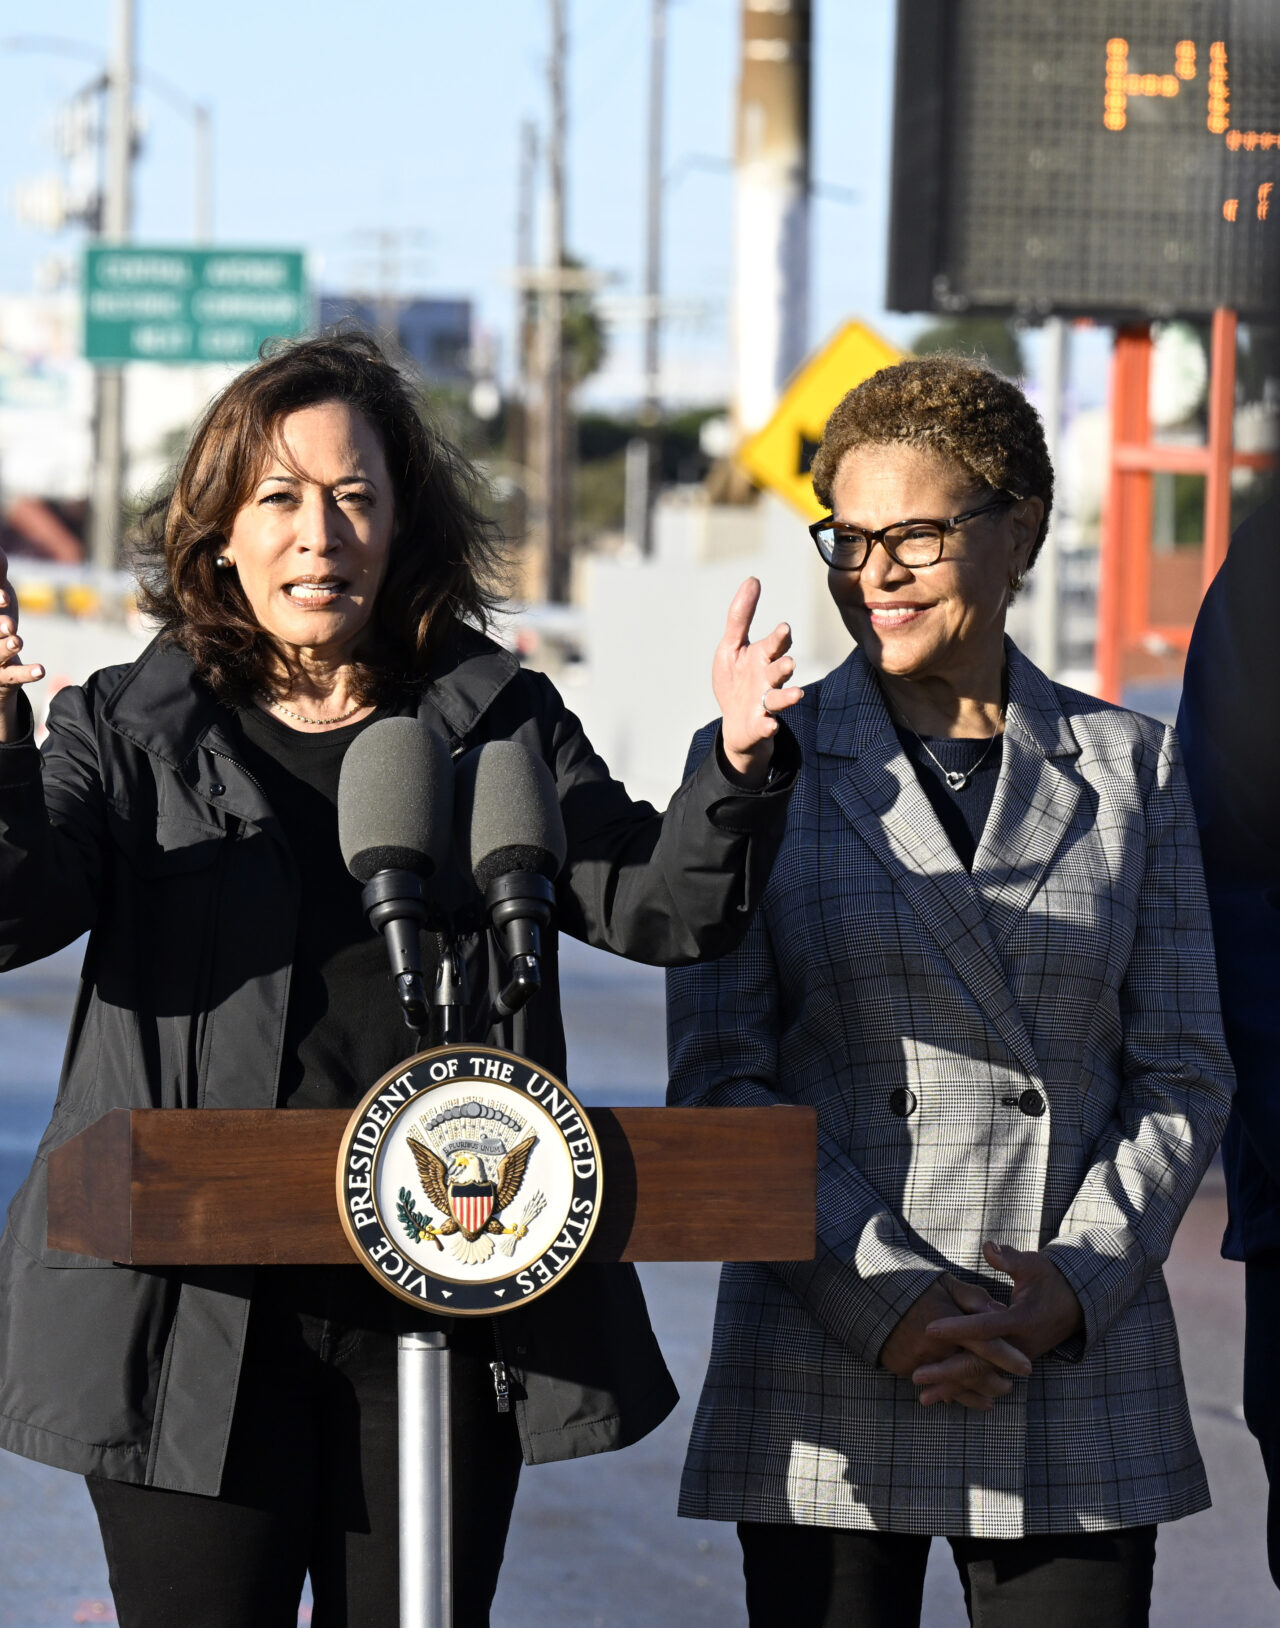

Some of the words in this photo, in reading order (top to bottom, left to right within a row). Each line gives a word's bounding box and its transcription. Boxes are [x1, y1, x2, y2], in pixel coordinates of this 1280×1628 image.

[429, 1059, 459, 1081] OF
[470, 1057, 514, 1083] THE
[349, 1072, 419, 1230] PRESIDENT
[481, 1144, 500, 1153] UNUM
[526, 1073, 595, 1179] UNITED
[370, 1238, 427, 1298] VICE
[516, 1197, 593, 1295] STATES
